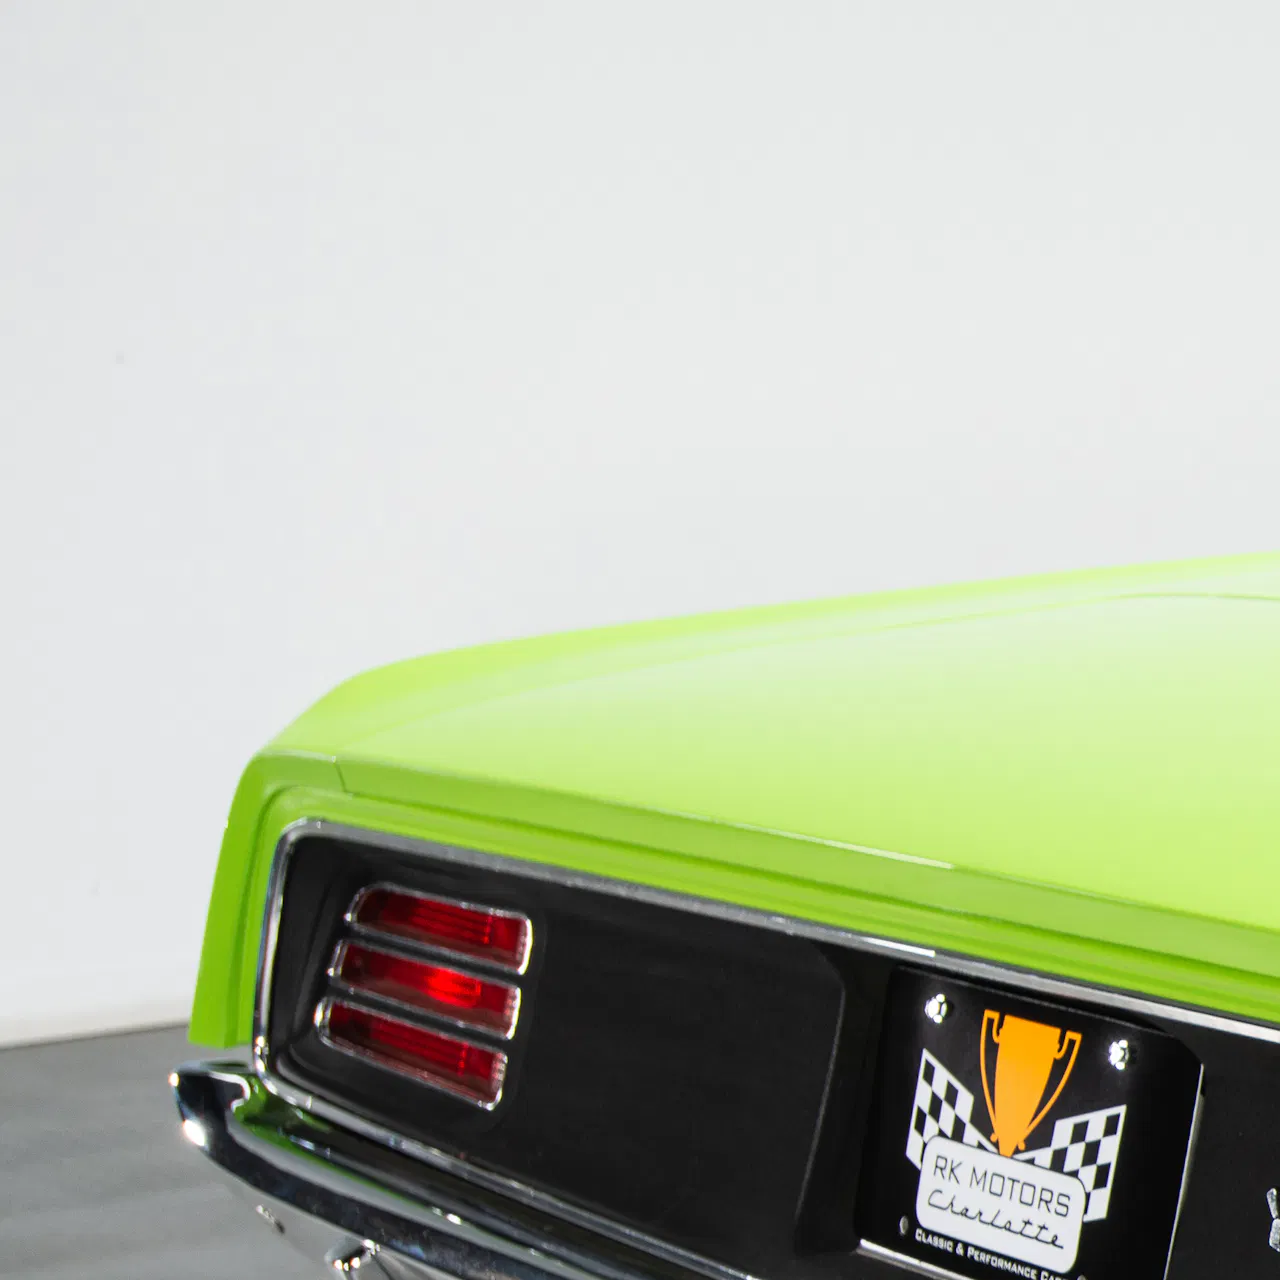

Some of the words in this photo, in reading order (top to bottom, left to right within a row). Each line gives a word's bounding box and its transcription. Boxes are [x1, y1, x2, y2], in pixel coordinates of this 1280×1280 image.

[933, 1155, 962, 1185] RK
[969, 1166, 1071, 1217] MOTORS
[927, 1189, 1064, 1250] Charlotte
[955, 1241, 965, 1257] &
